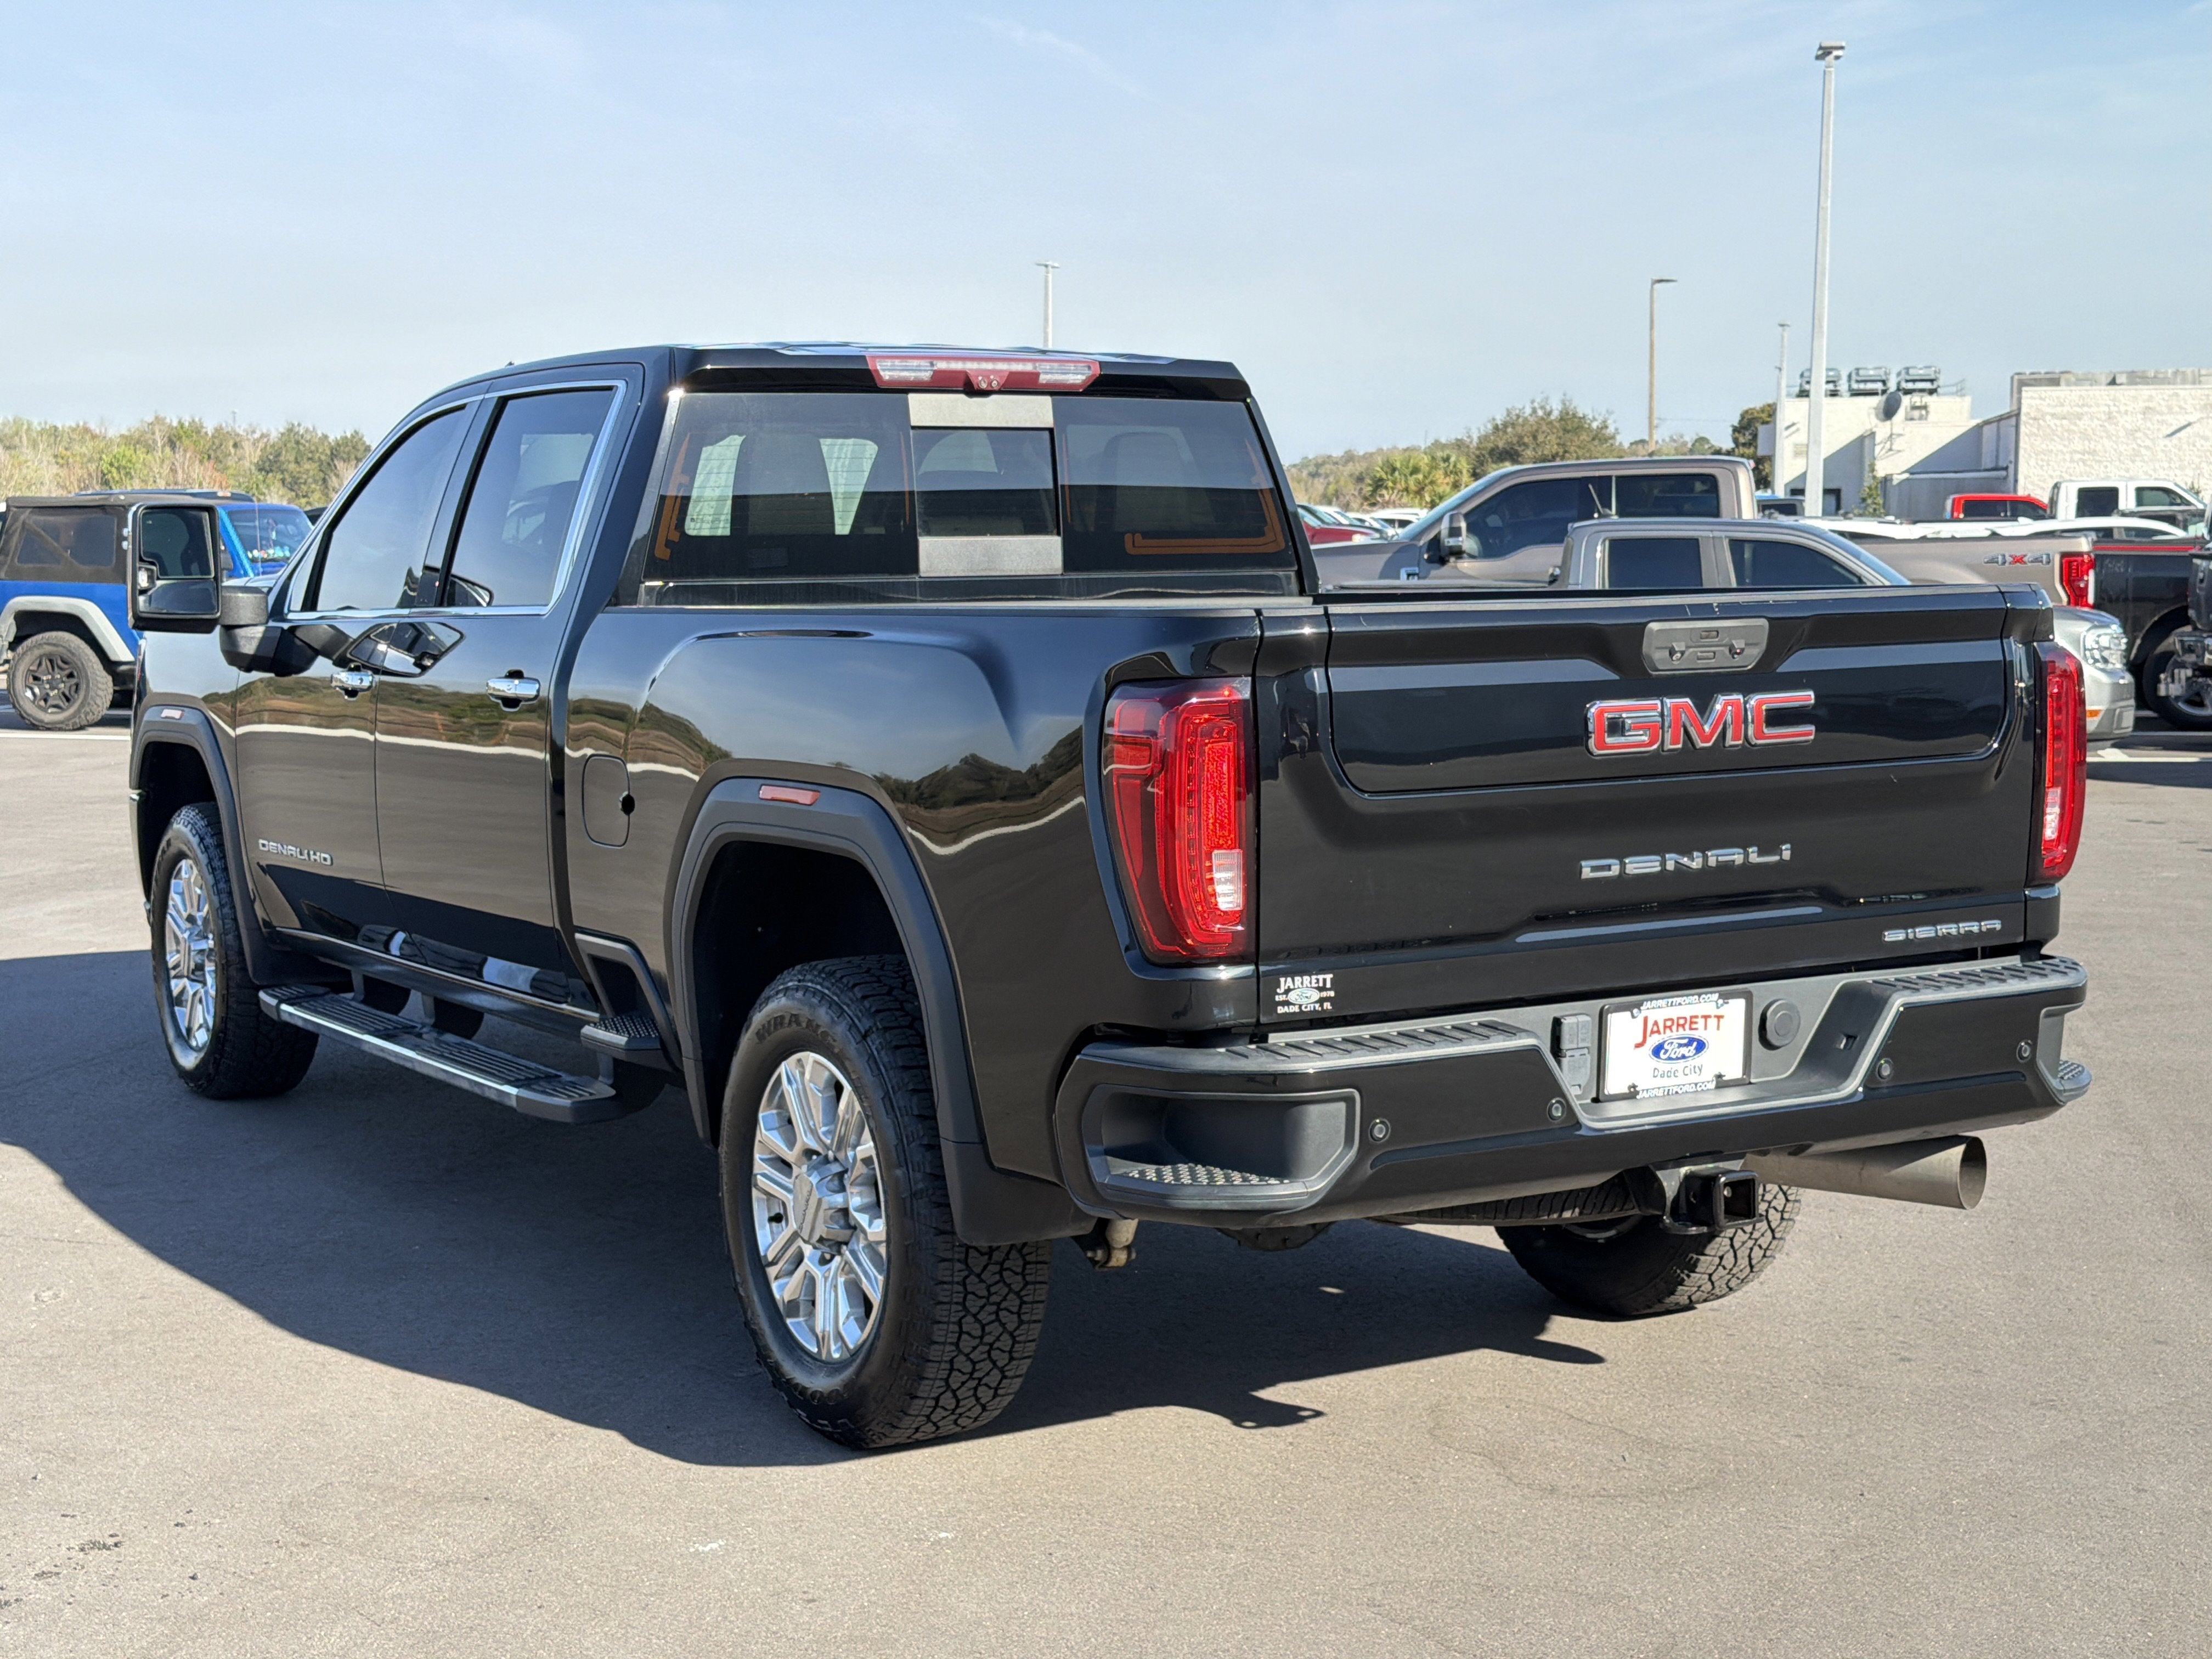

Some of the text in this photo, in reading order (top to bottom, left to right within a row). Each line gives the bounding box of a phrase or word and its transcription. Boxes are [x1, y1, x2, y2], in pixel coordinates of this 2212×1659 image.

[1585, 690, 1815, 758] GMC
[258, 838, 333, 866] DENALI HD
[1580, 843, 1791, 879] DENALI
[1883, 919, 2002, 941] SIERRA
[1276, 973, 1334, 994] JARRETT
[1277, 1005, 1300, 1014] DADE
[1301, 1003, 1322, 1012] CITY,
[1640, 993, 1719, 1010] JARRETTFORD.COM
[1634, 1015, 1725, 1049] JARRETT
[1660, 1039, 1697, 1059] Ford
[1652, 1064, 1703, 1078] Dade City
[1636, 1079, 1716, 1099] JARRETTFORD.COM
